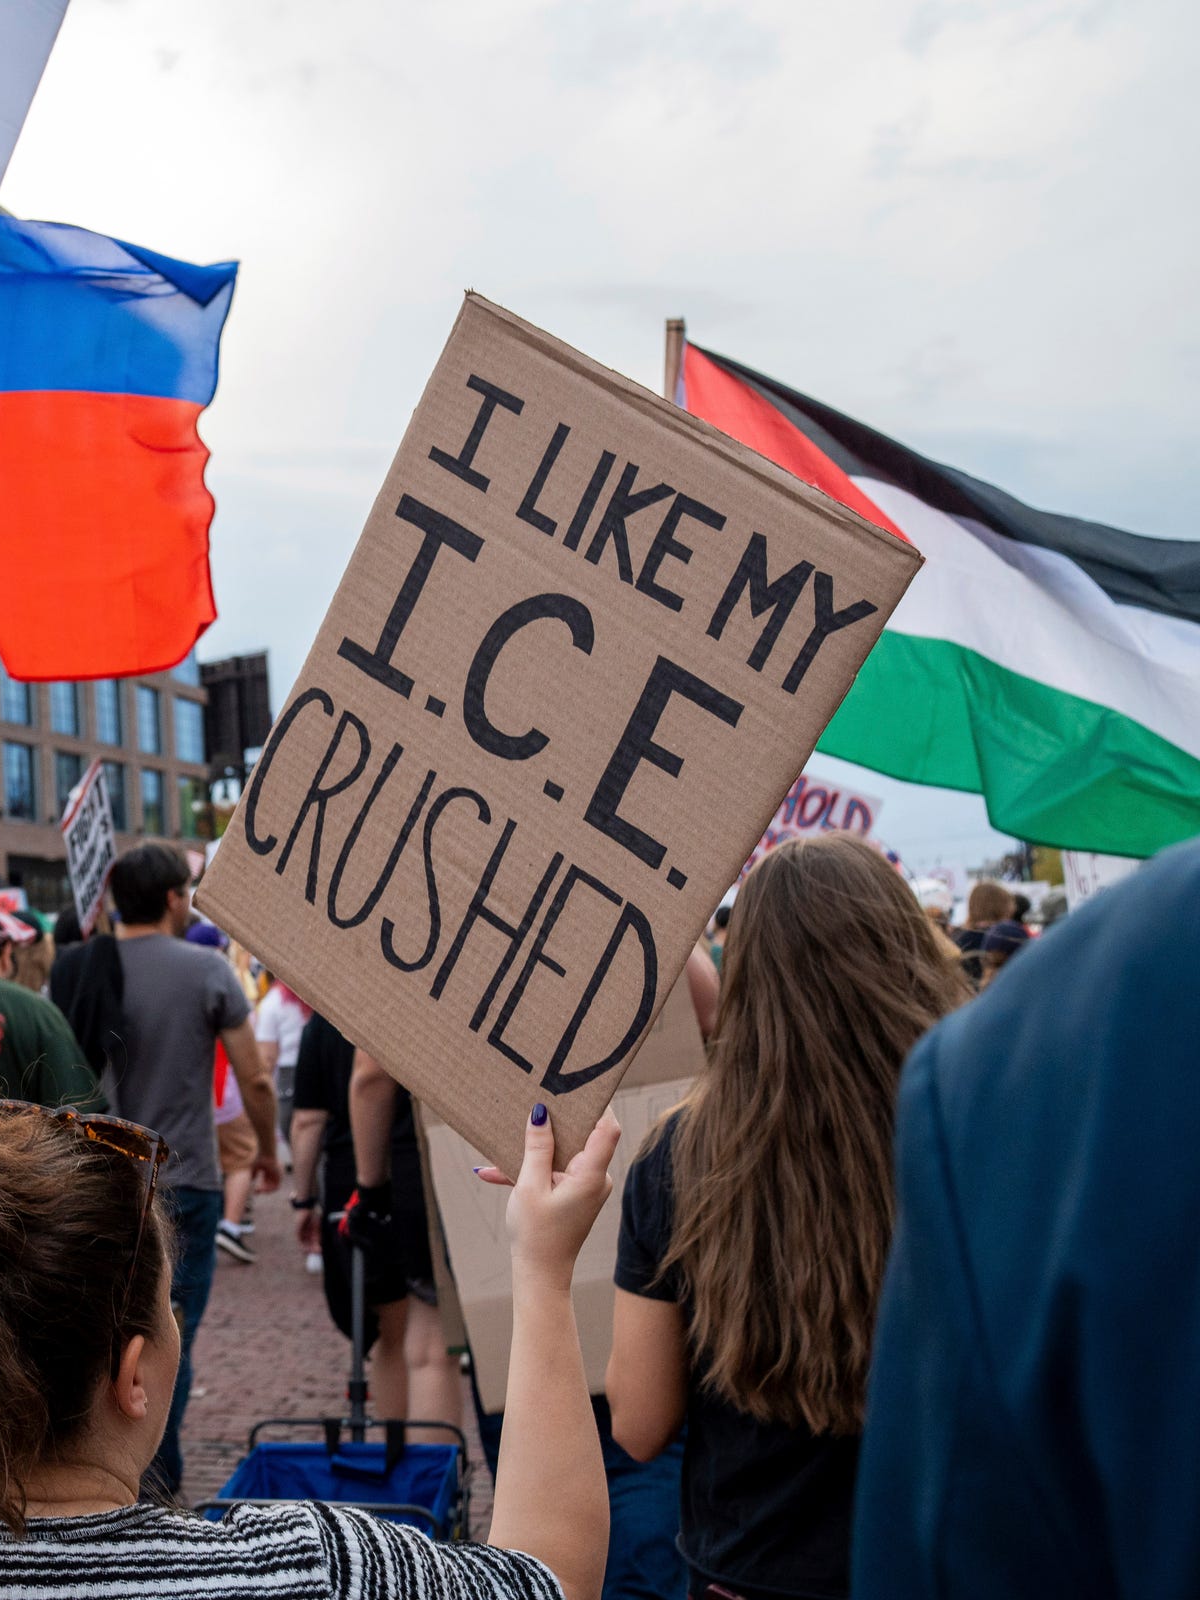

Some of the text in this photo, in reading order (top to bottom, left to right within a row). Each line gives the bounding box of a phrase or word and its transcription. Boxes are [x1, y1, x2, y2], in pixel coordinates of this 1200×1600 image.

[428, 374, 878, 694] I LIKE MY
[244, 687, 658, 1095] CRUSHED
